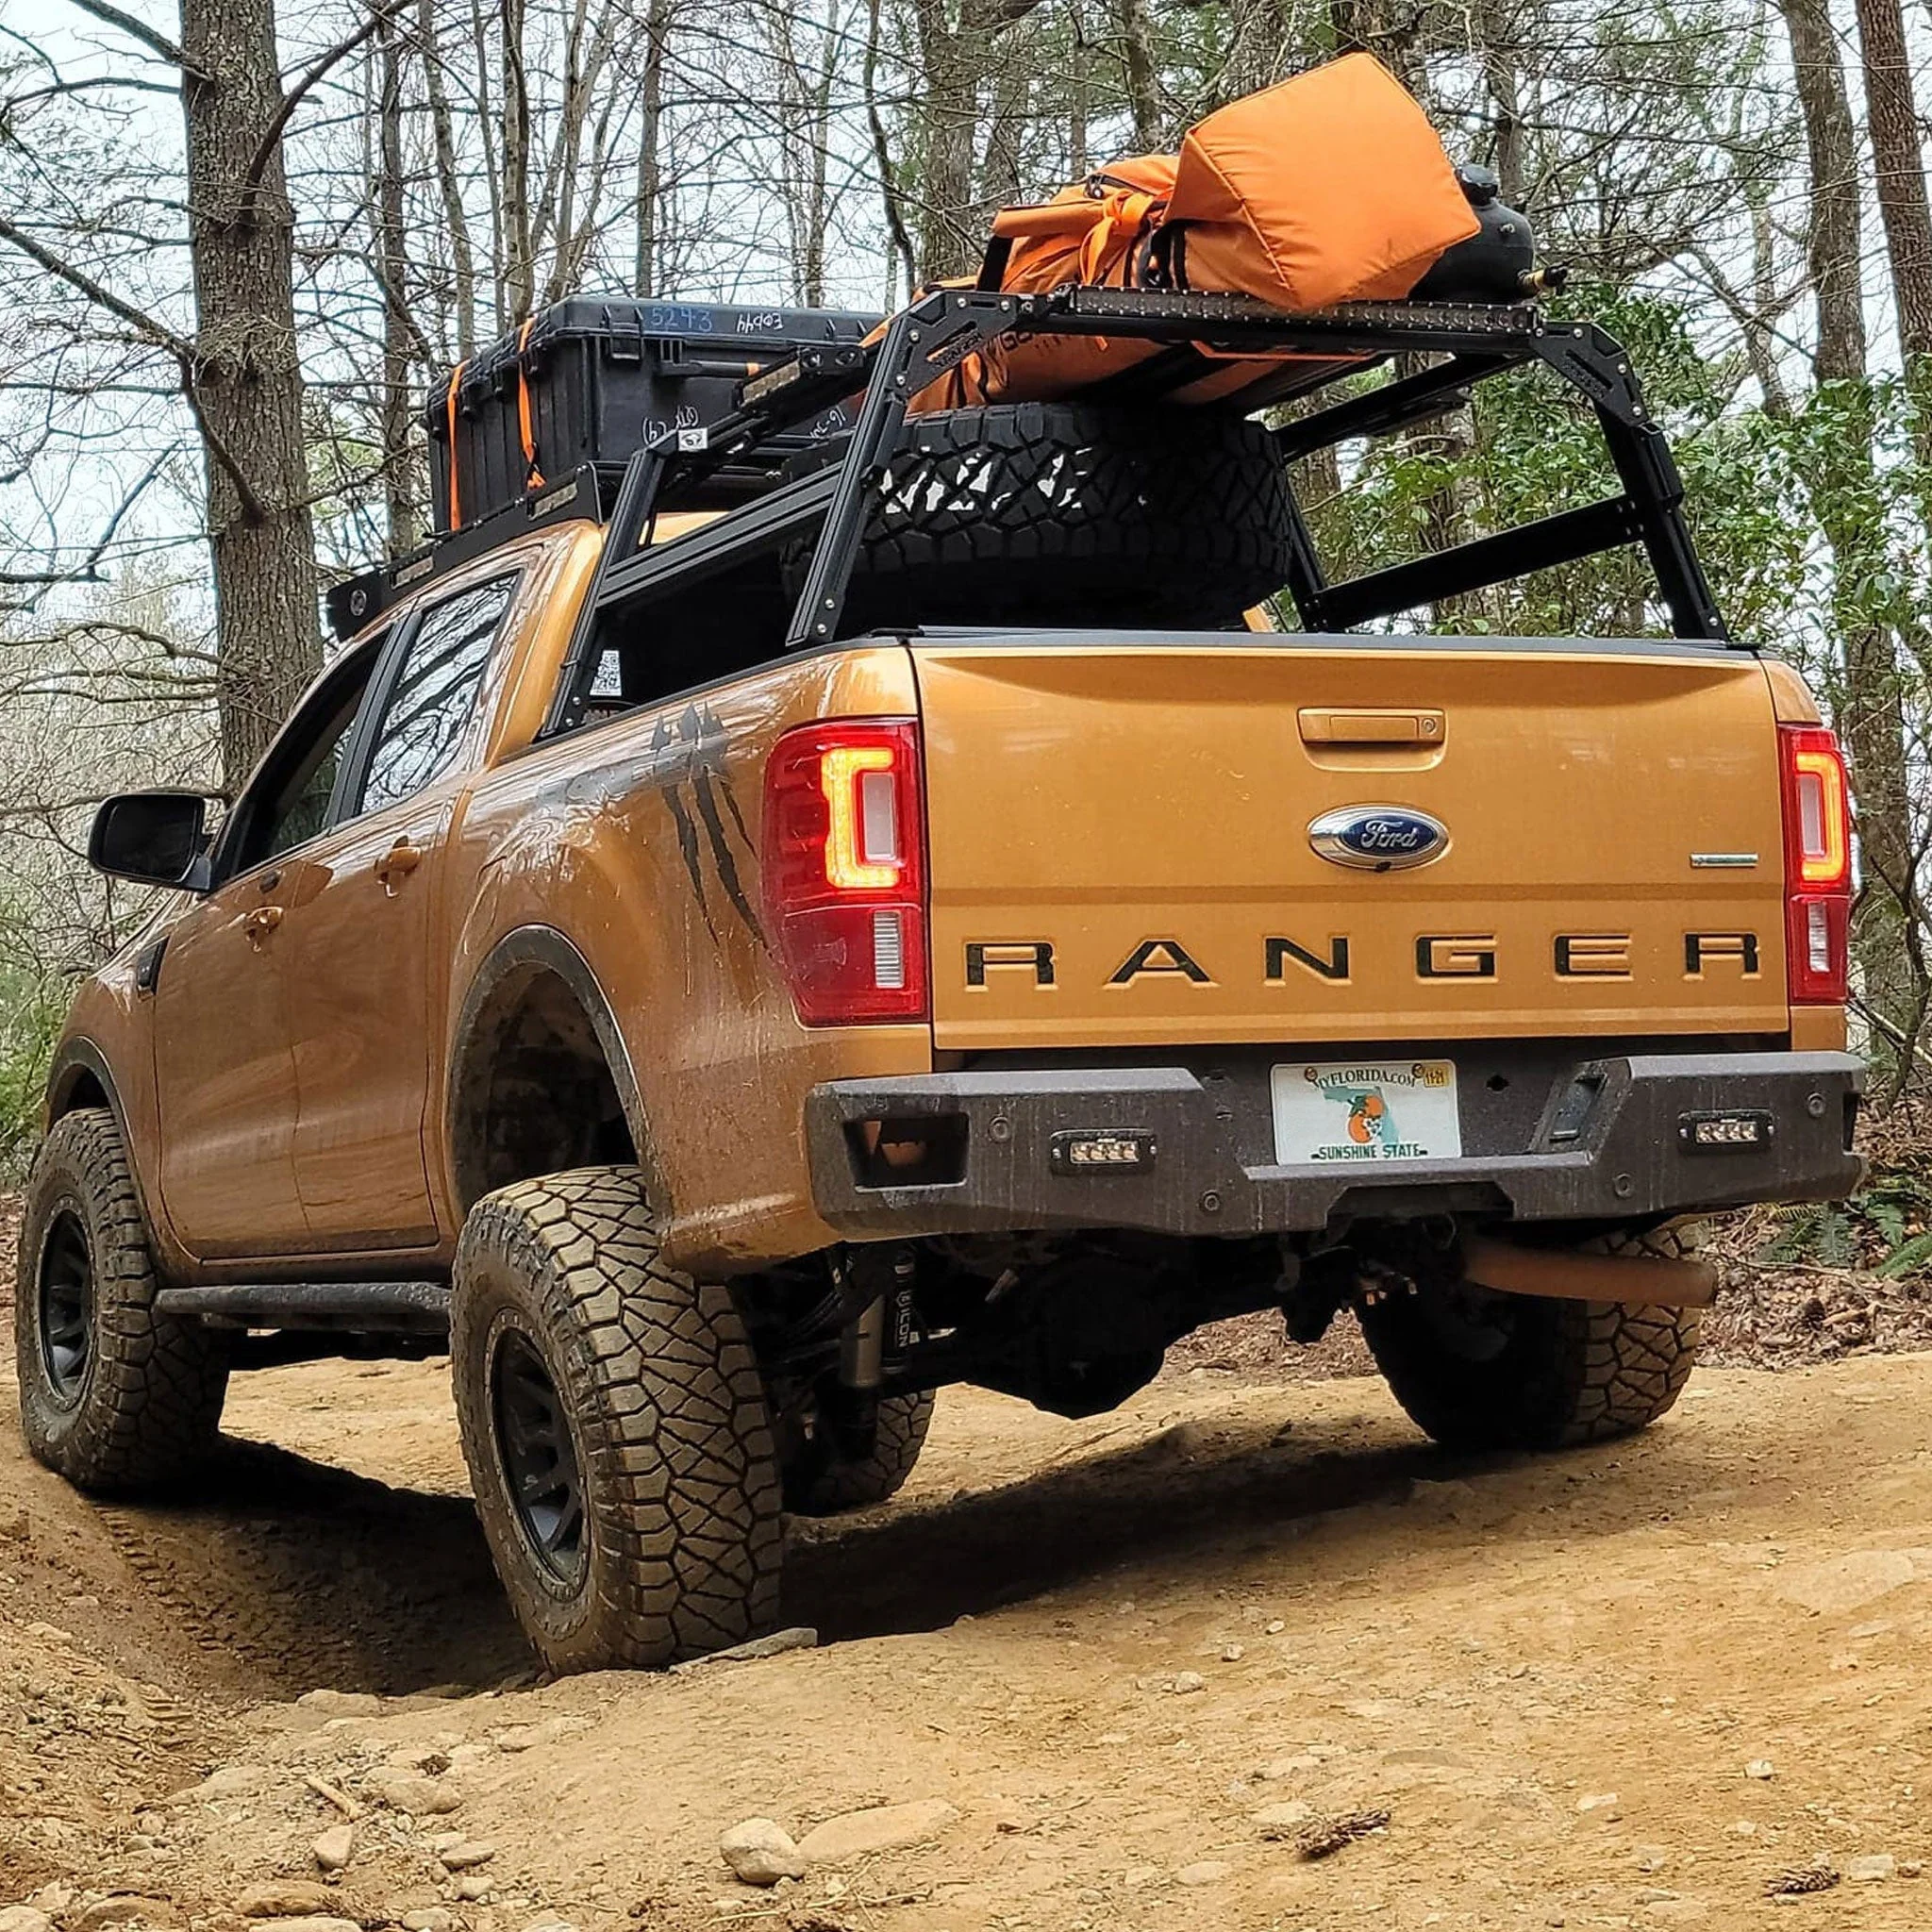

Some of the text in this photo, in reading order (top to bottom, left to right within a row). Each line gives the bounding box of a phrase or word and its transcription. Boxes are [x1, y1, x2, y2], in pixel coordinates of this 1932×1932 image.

[650, 306, 713, 332] 5243
[1359, 819, 1418, 848] Ford
[964, 932, 1760, 991] RANGER
[1318, 1142, 1420, 1160] SUNSHINE STATE
